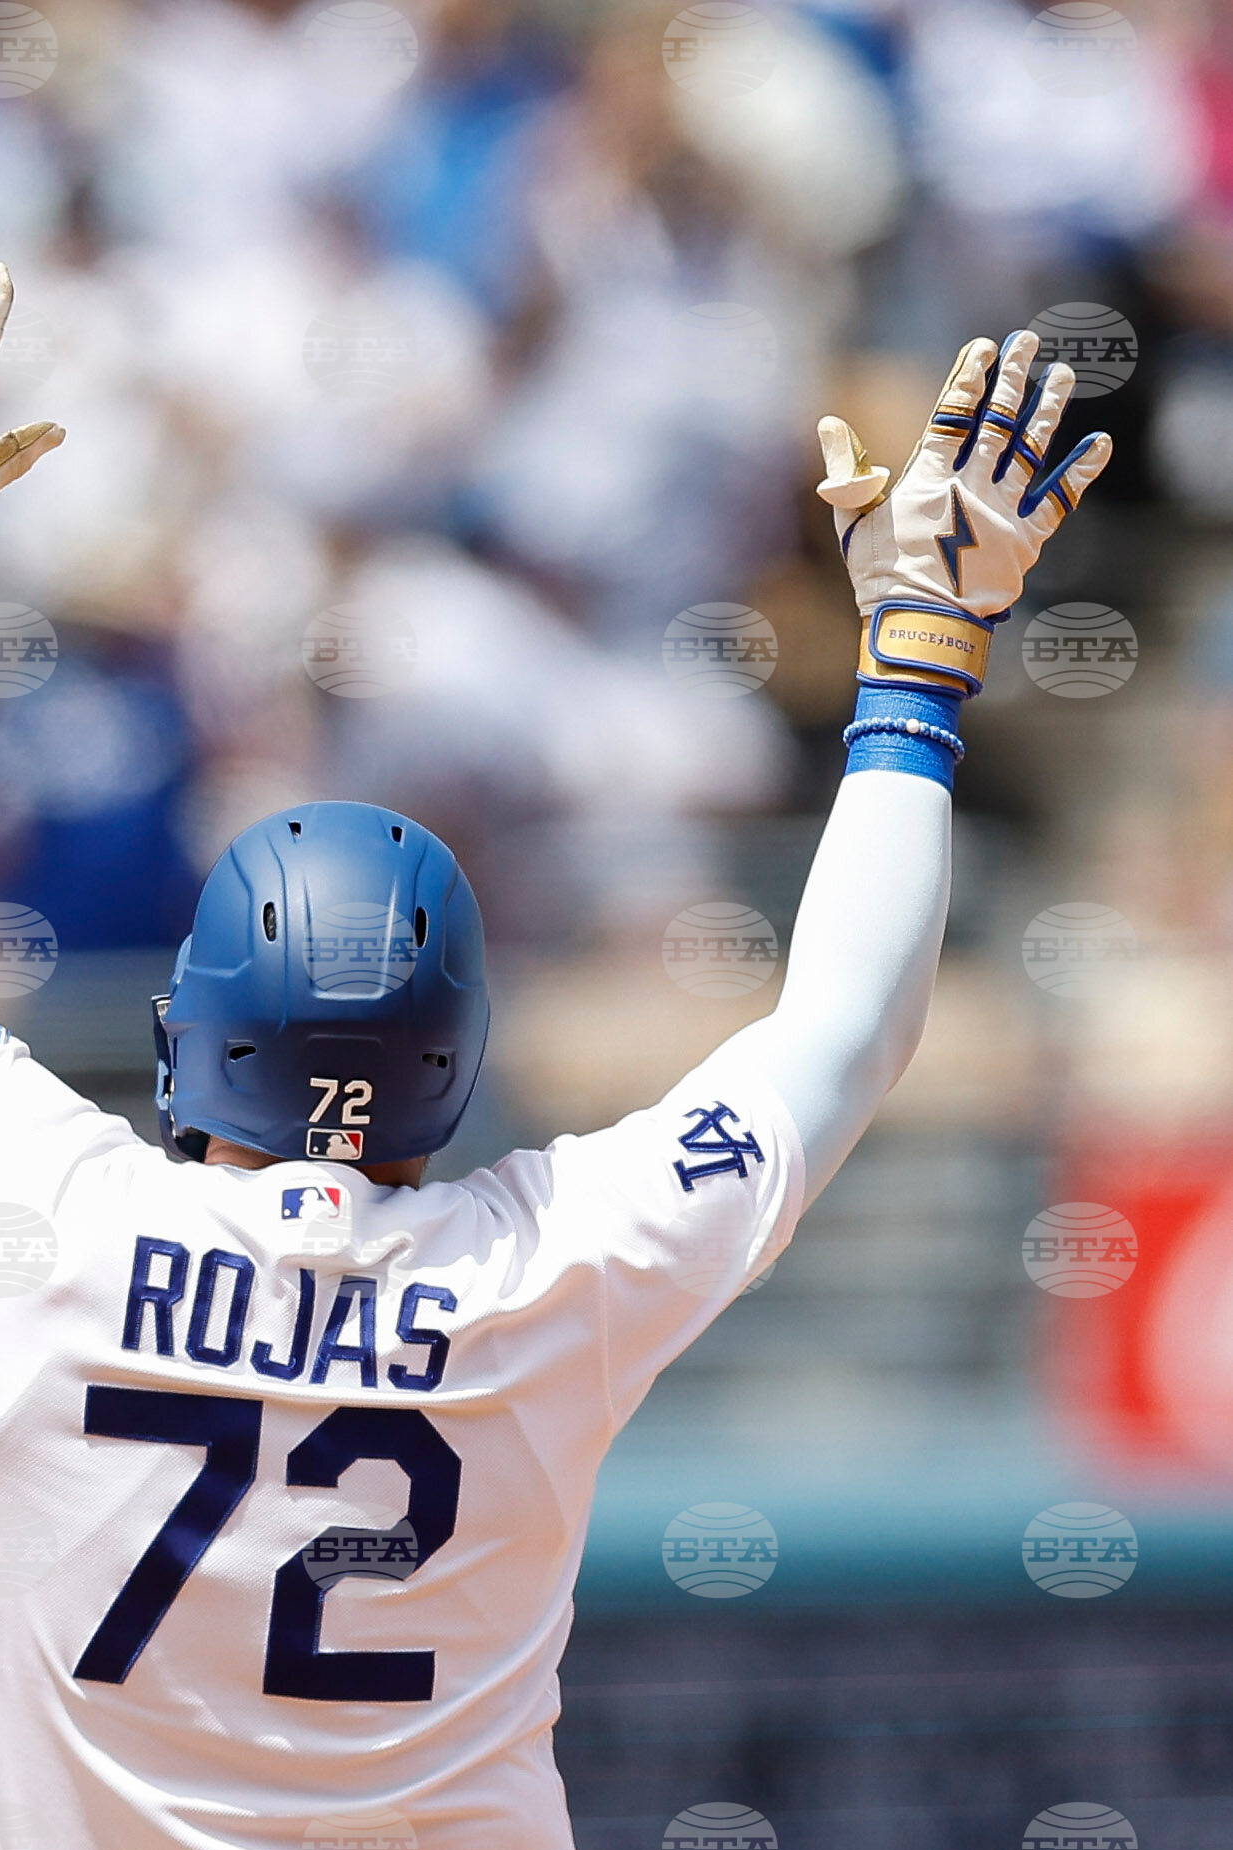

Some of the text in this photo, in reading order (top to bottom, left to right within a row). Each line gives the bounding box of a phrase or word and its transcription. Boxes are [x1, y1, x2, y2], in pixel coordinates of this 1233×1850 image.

[889, 629, 975, 654] BRUCE BOLT
[308, 1077, 373, 1125] 72
[121, 1234, 459, 1393] ROJAS
[73, 1384, 463, 1702] 72
